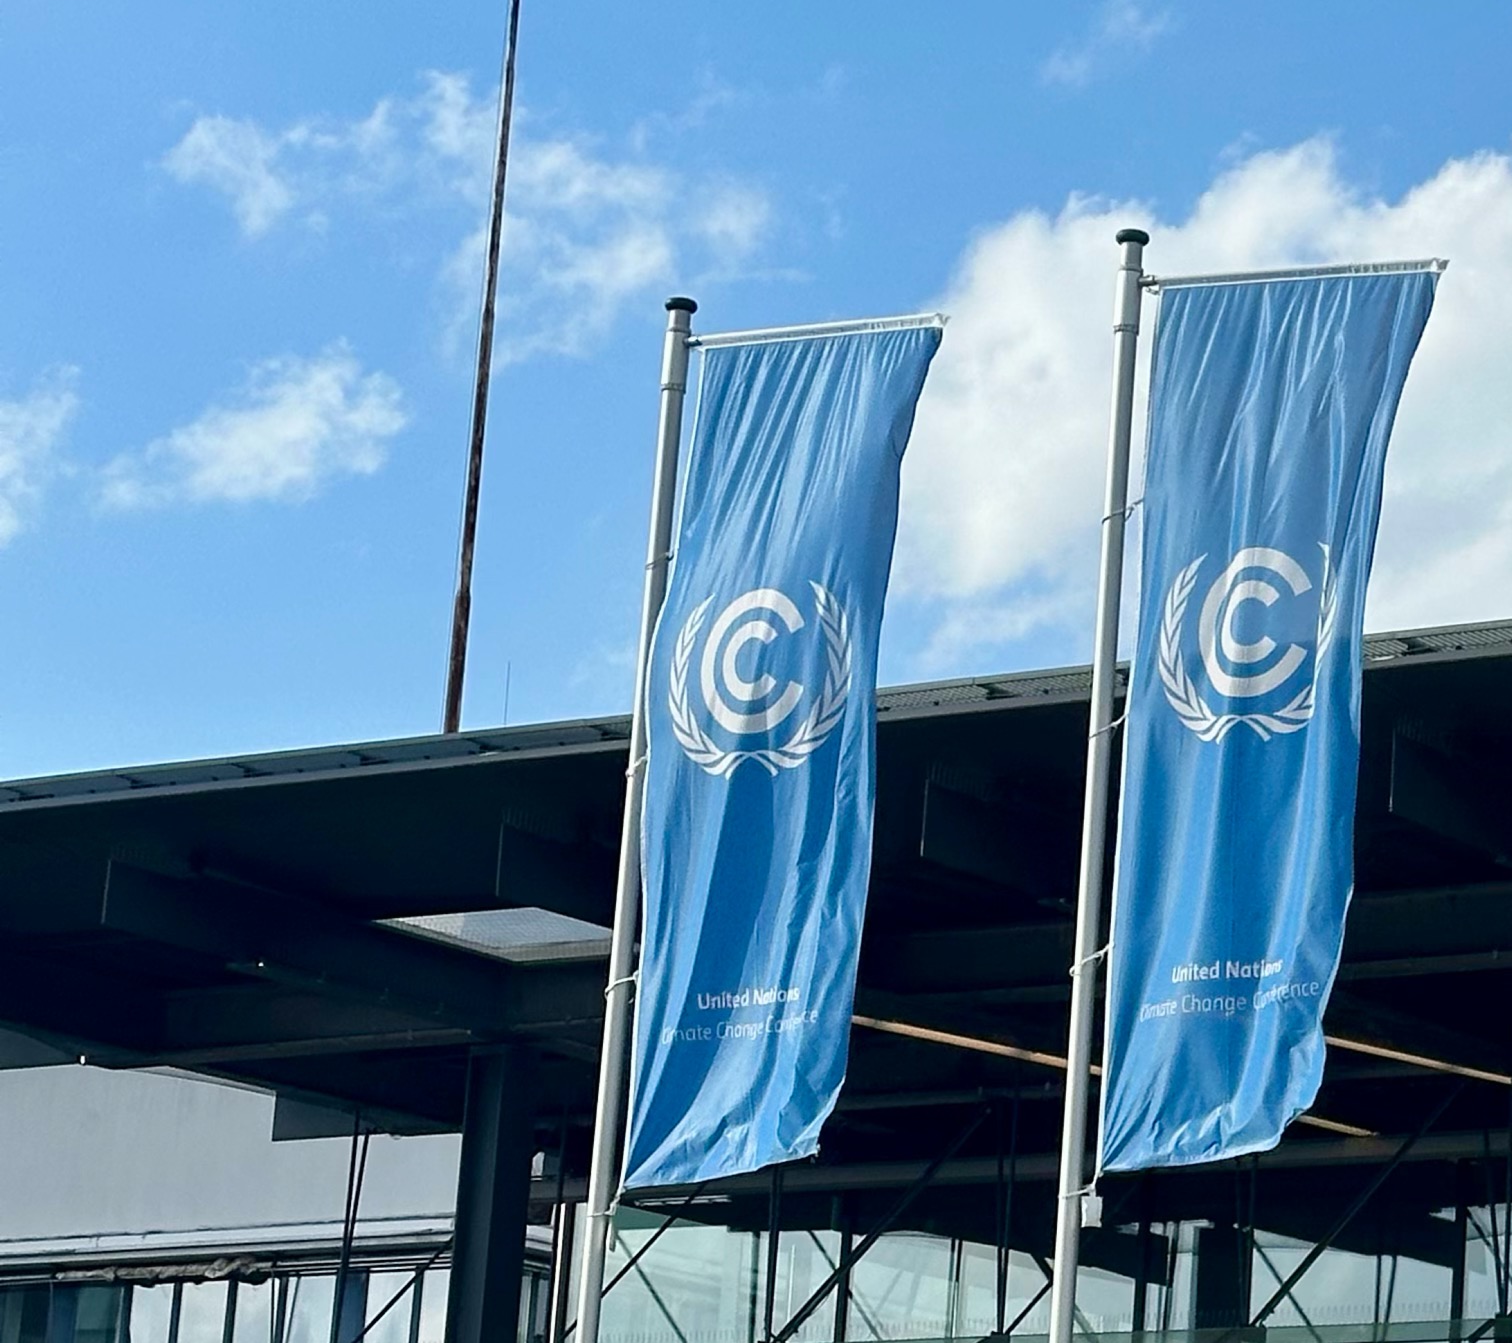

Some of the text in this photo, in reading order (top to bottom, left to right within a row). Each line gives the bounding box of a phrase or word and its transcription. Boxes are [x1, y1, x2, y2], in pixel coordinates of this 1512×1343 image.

[1172, 958, 1283, 984] United Nations
[697, 984, 801, 1011] United Nations
[1182, 994, 1247, 1016] Change
[661, 1009, 819, 1045] Cmate Change Confce
